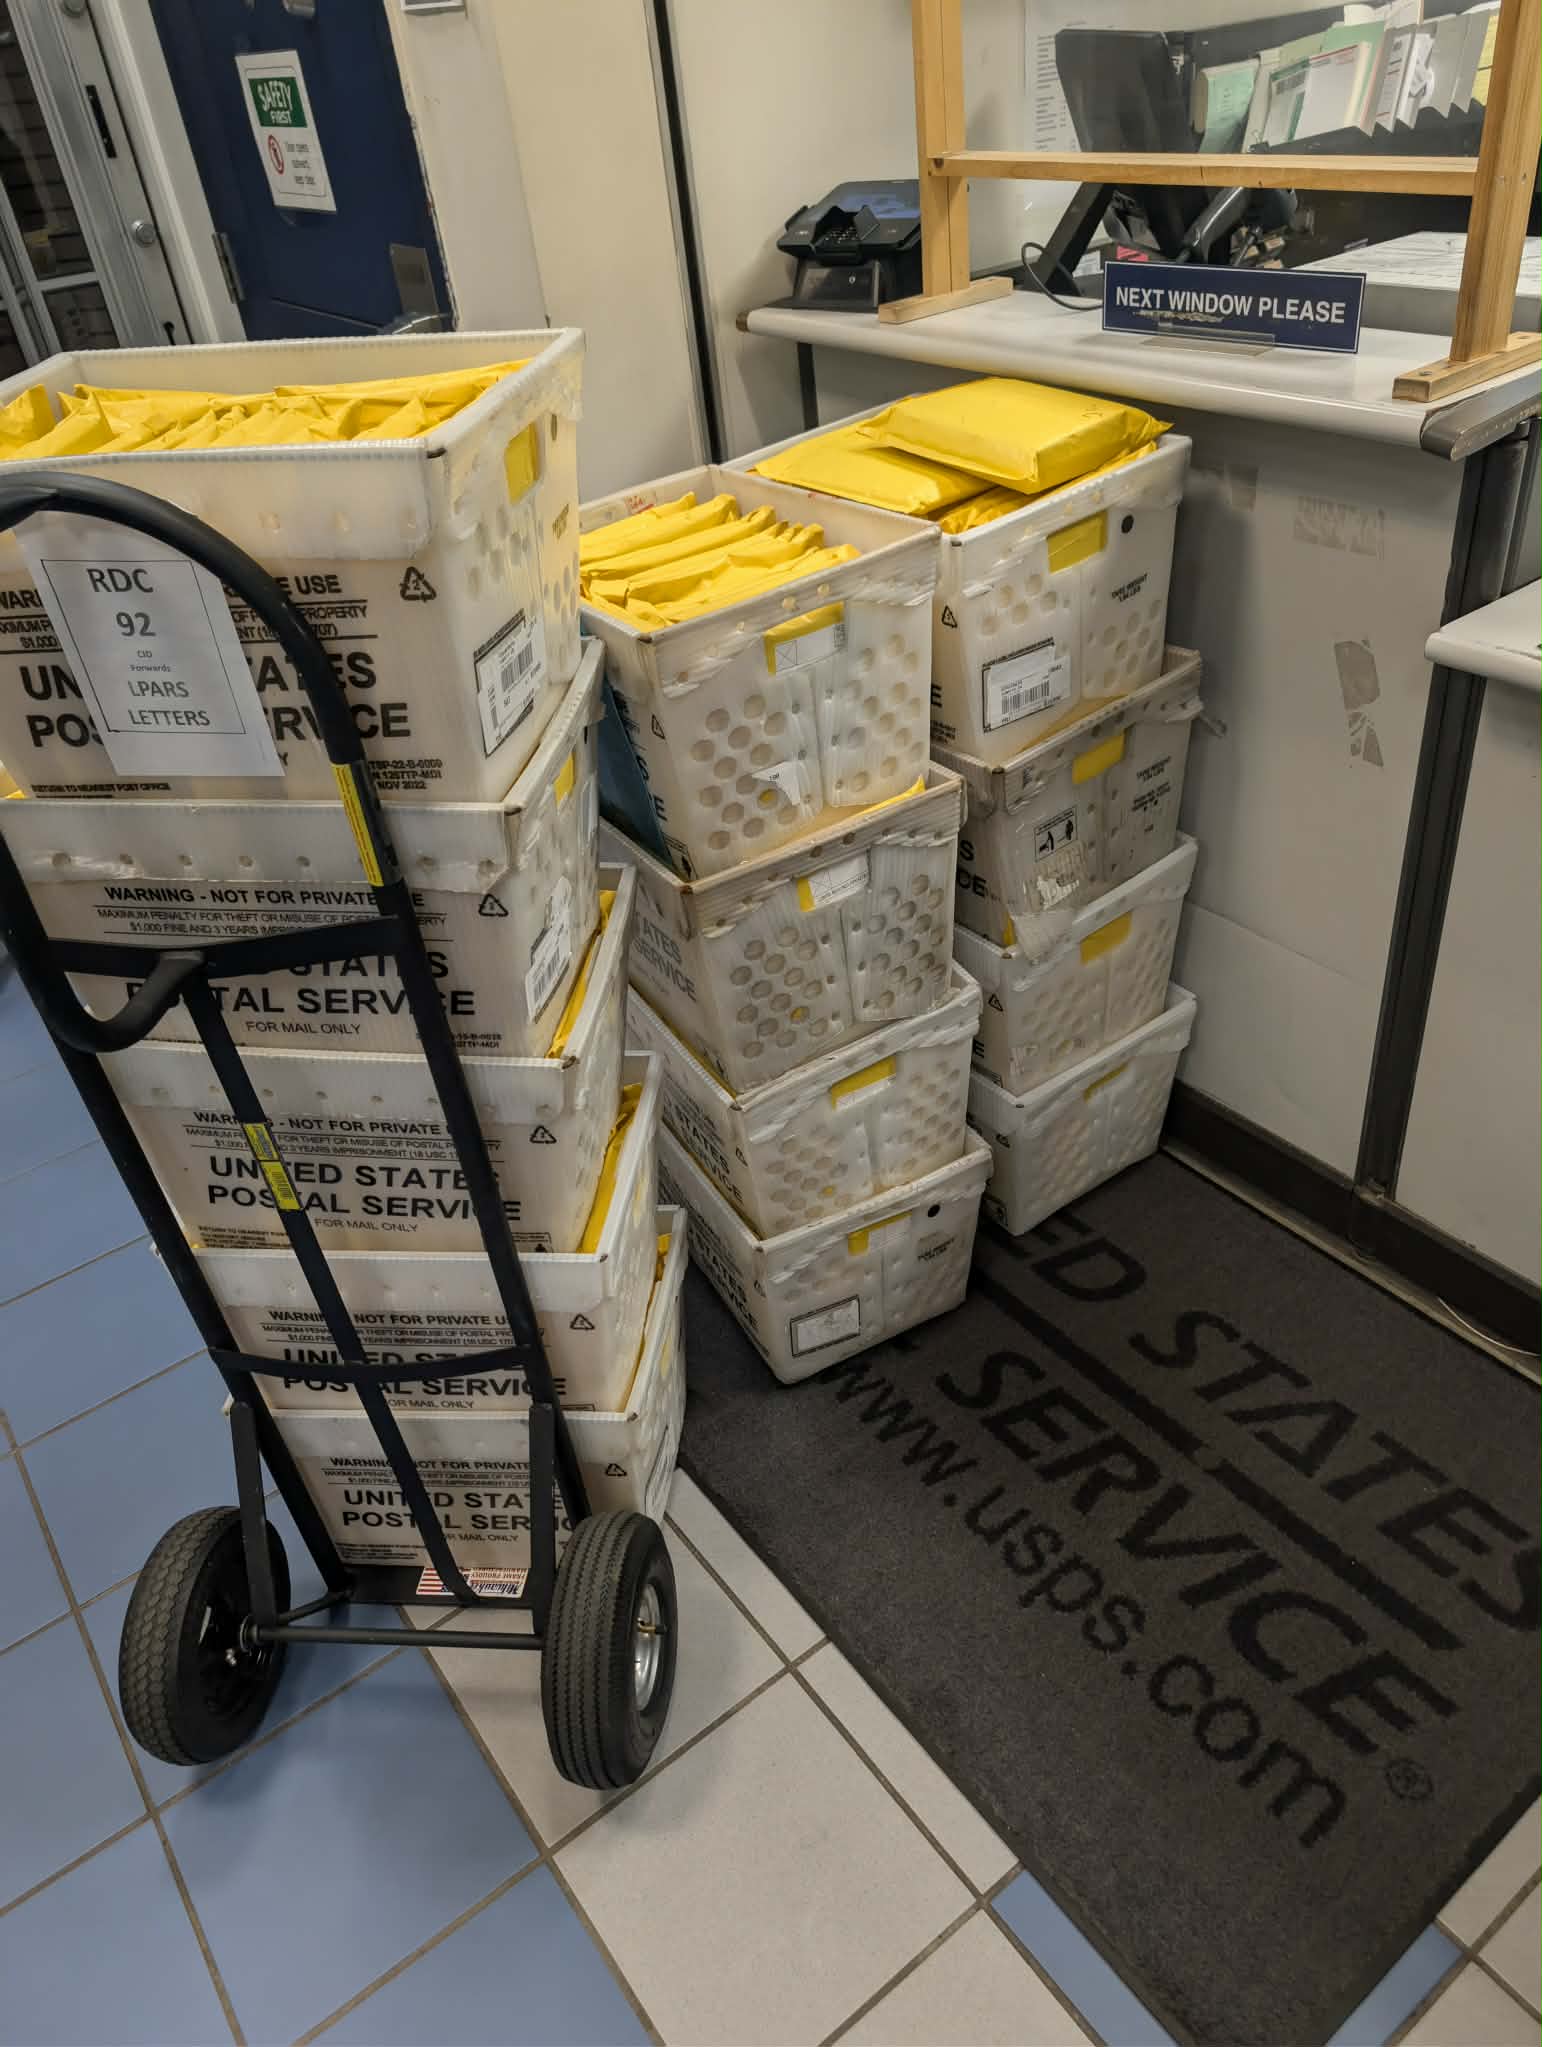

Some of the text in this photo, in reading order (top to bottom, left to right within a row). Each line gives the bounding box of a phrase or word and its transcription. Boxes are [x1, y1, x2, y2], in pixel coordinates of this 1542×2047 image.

[256, 80, 293, 113] SAFETY
[270, 110, 292, 124] FIRST
[1116, 286, 1346, 324] NEXT WINDOW PLEASE
[86, 568, 154, 593] RDC
[295, 575, 342, 595] USE
[116, 611, 157, 637] 92
[127, 680, 190, 698] LPARS
[128, 709, 211, 726] LETTERS
[105, 886, 194, 903] WARNING
[210, 889, 249, 904] NOT
[255, 889, 296, 905] FOR
[300, 890, 377, 906] PRIVATE
[97, 909, 148, 920] MAXIMUM
[151, 910, 197, 921] PENALTY
[200, 912, 223, 922] FOR
[224, 913, 259, 922] THEFT
[297, 986, 475, 1016] SERVE
[246, 1020, 361, 1036] FOR MAIL ONLY
[193, 1111, 274, 1128] WARG
[288, 1118, 323, 1130] NOT
[329, 1119, 366, 1133] FOR
[369, 1121, 440, 1135] PRIVATE
[210, 1155, 498, 1190] UNED STATE
[207, 1184, 521, 1221] POSAL SERVIE
[315, 1218, 419, 1233] FOR MAIL ONLY
[269, 1311, 494, 1326] WARNI NOT FOR PRIVATE
[283, 1348, 403, 1365] UNIED
[388, 1401, 474, 1410] OR MAIL ONLY
[416, 1460, 436, 1470] OT
[442, 1461, 469, 1470] FOR
[1127, 1310, 1542, 1631] STATES
[343, 1489, 454, 1508] UNITD
[342, 1511, 461, 1529] POSTL
[487, 1534, 519, 1543] ONLY
[935, 1350, 1460, 1756] SERVICE
